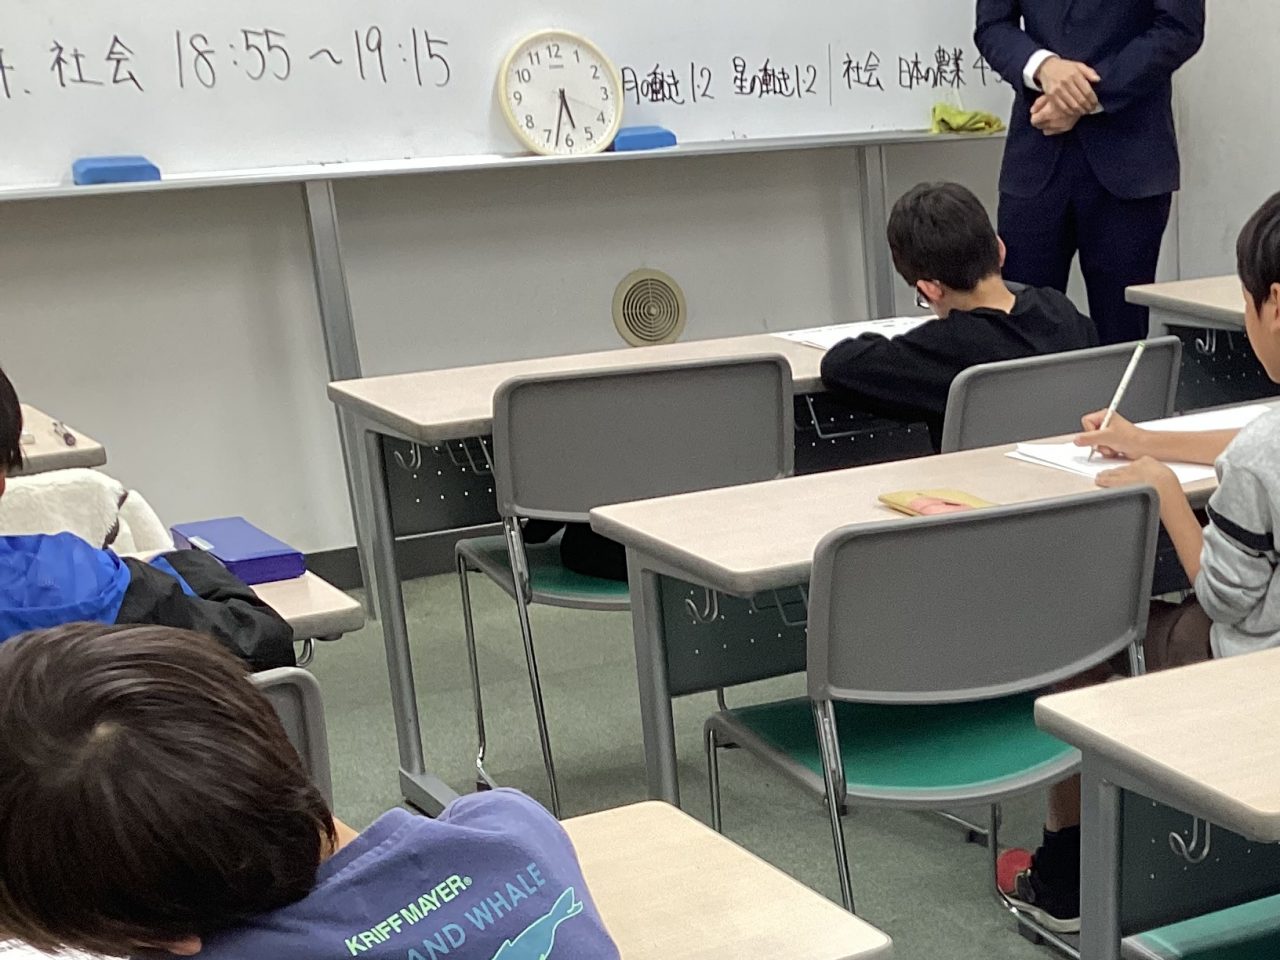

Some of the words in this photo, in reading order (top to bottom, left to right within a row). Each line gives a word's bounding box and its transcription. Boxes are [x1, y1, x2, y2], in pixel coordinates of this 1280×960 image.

[528, 51, 541, 65] 11
[545, 43, 562, 59] 12
[573, 49, 580, 63] 1
[49, 33, 145, 92] 社会
[842, 50, 885, 91] 社会
[515, 67, 531, 83] 10
[590, 64, 600, 80] 2
[513, 90, 522, 106] 9
[600, 86, 609, 101] 3
[525, 113, 535, 129] 8
[596, 110, 605, 125] 4
[543, 128, 552, 143] 7
[565, 133, 574, 148] 6
[584, 126, 593, 141] 5
[463, 862, 546, 931] WHALE
